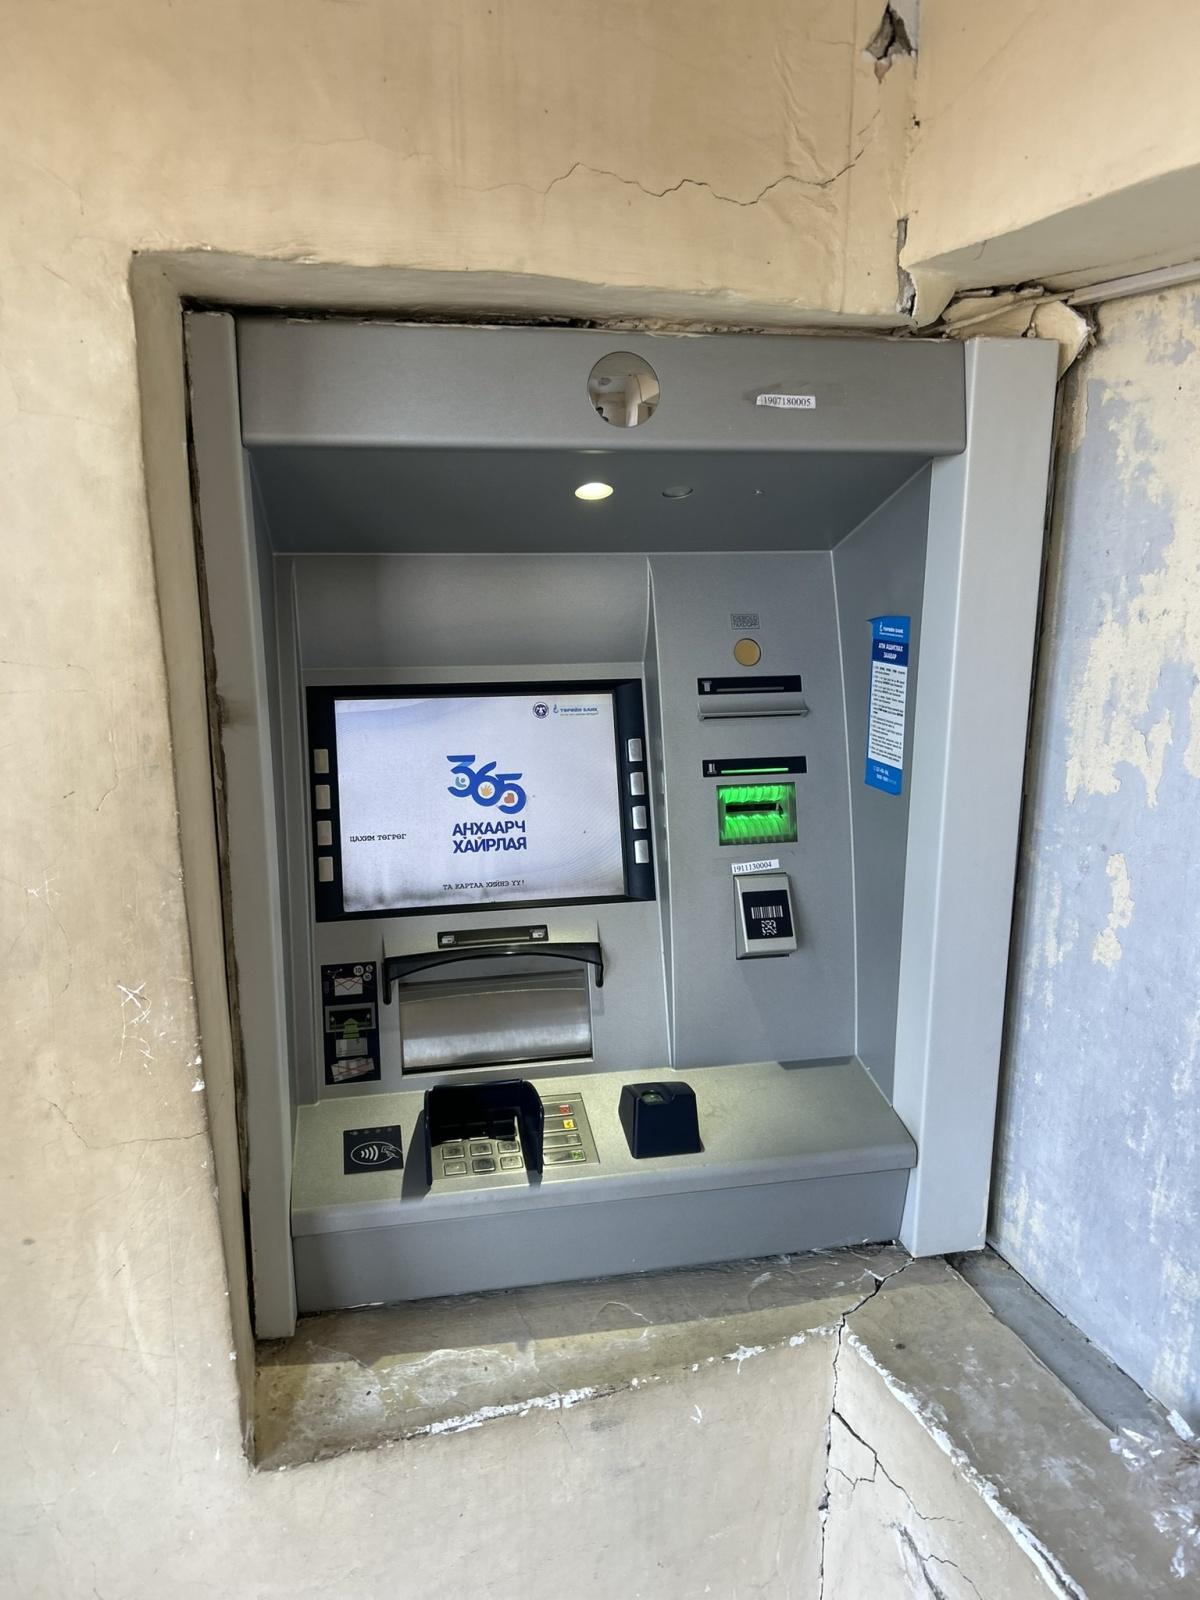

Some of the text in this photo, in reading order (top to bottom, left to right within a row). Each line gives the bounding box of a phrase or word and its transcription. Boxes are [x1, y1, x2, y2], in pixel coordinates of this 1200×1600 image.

[764, 396, 811, 407] 1907180005
[446, 754, 527, 815] 365
[452, 820, 526, 837] АНХААРЧ
[349, 833, 407, 843] ЦАХИМ ТӨГРӨГ
[452, 836, 527, 854] ХАЙРЛАЯ
[733, 861, 772, 872] 1911130004
[442, 883, 453, 891] ТА
[455, 882, 484, 890] КАРТАА
